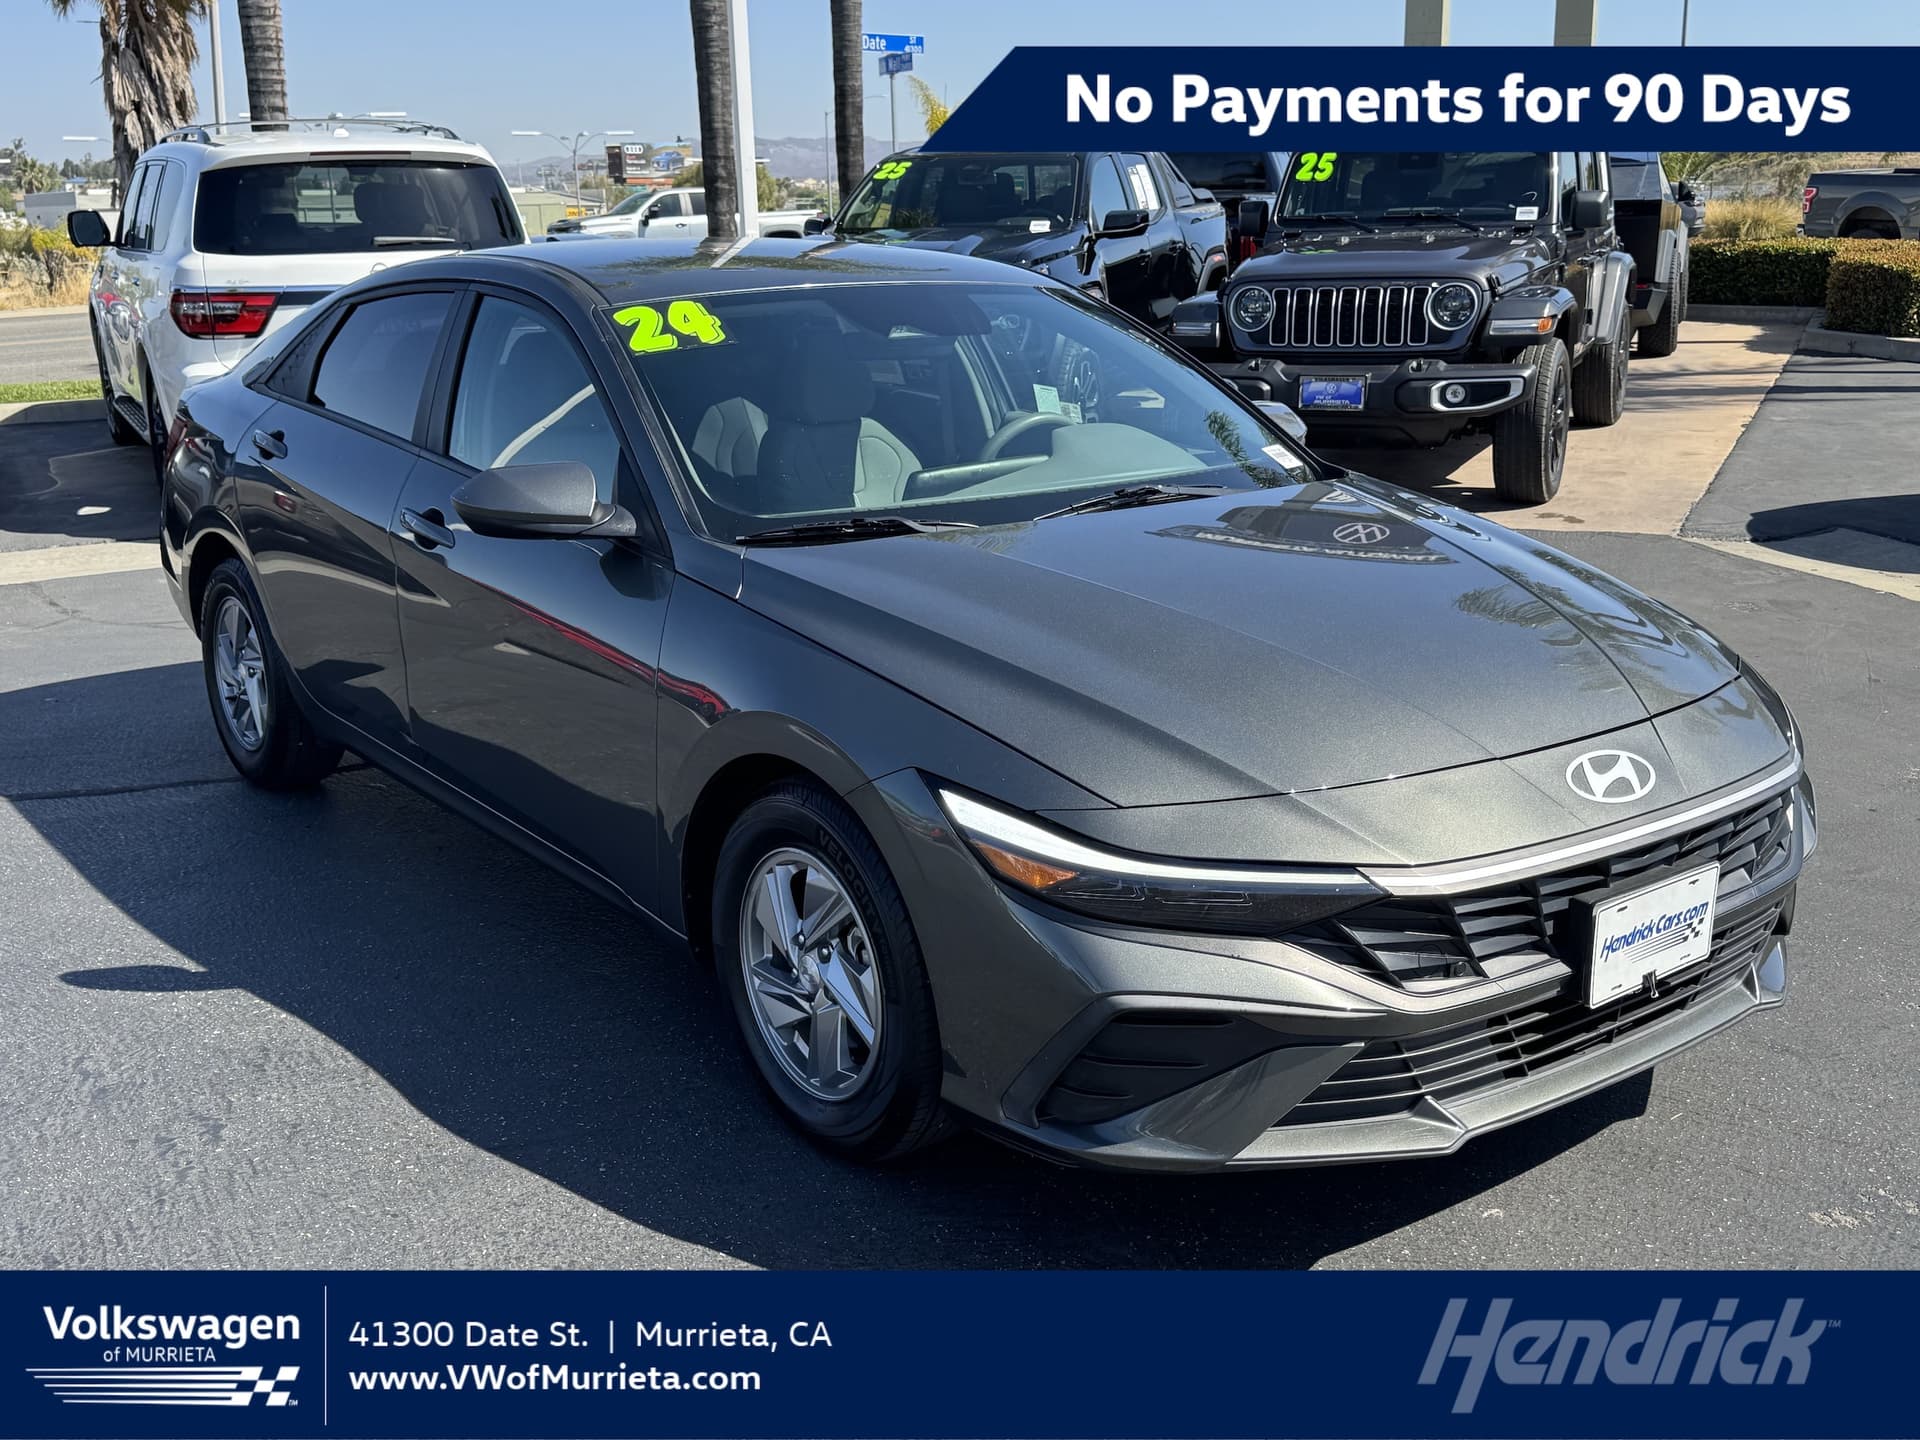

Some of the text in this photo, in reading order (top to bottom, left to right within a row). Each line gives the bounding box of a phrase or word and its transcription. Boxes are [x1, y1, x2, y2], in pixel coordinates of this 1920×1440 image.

[862, 36, 887, 50] Date
[873, 161, 912, 181] 25
[1295, 152, 1337, 182] 25
[612, 300, 727, 353] 24
